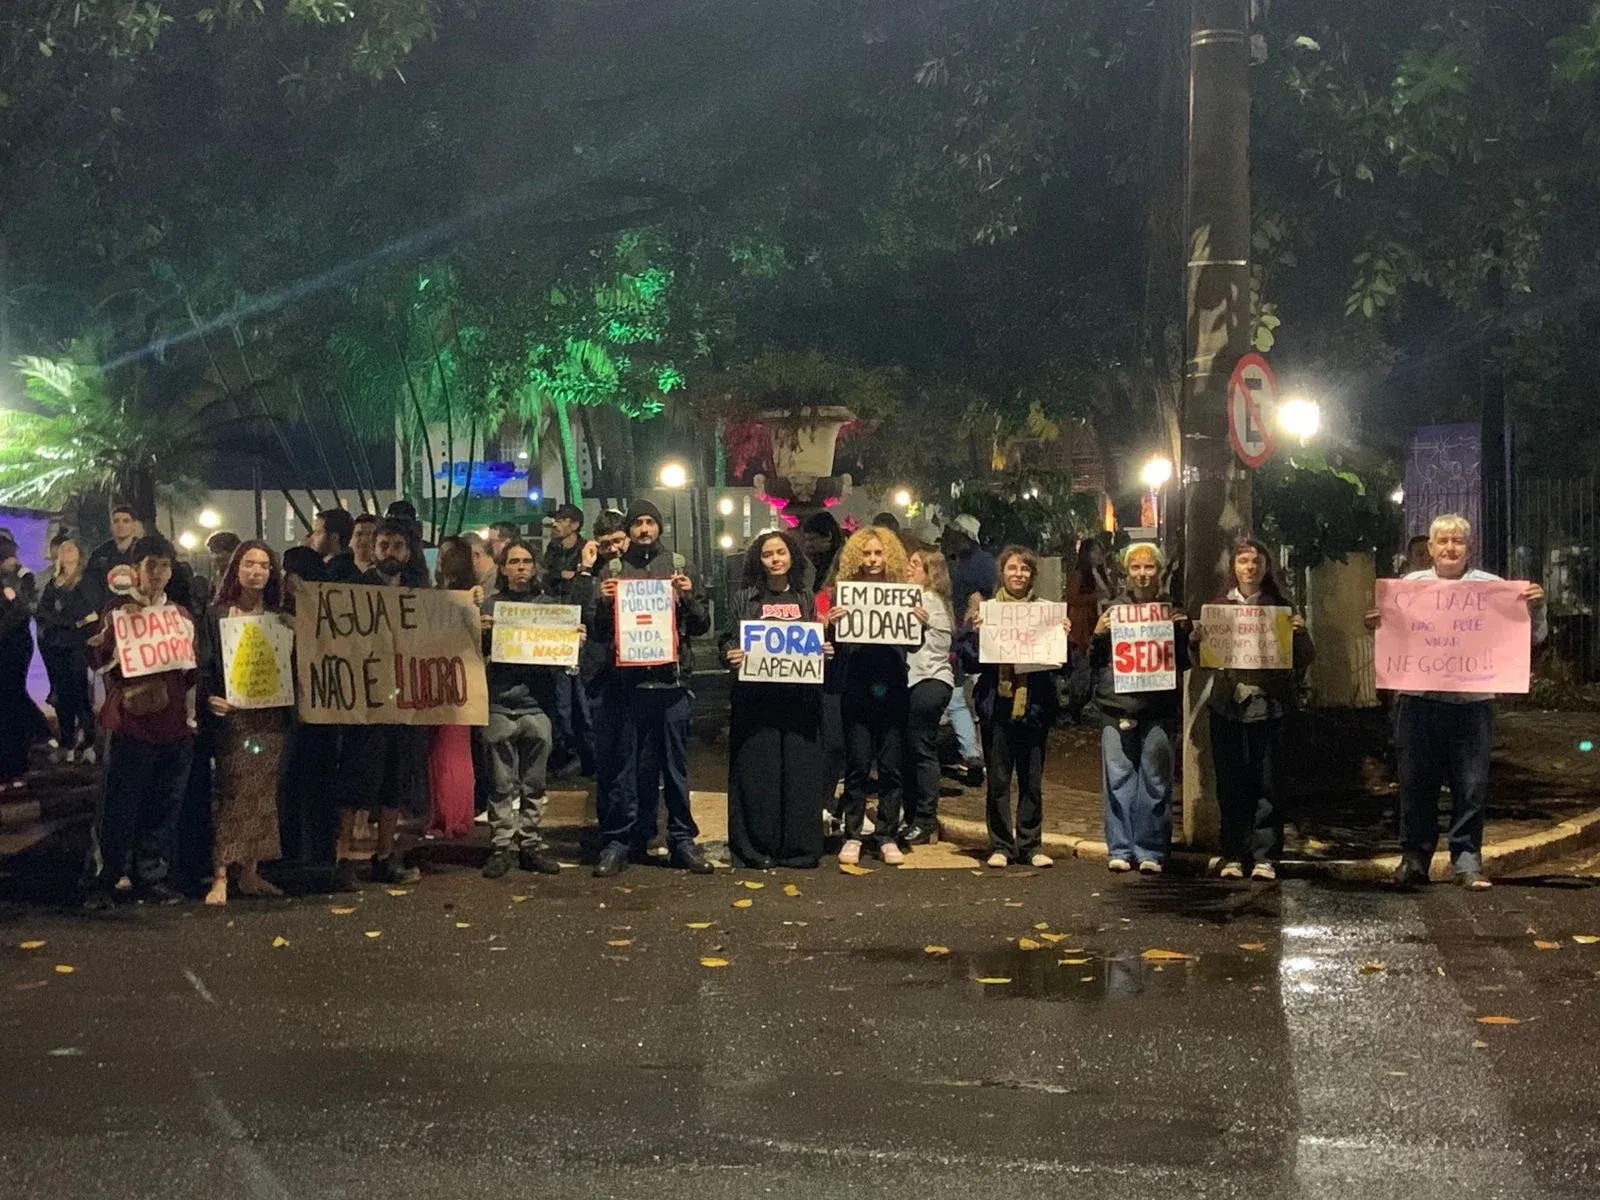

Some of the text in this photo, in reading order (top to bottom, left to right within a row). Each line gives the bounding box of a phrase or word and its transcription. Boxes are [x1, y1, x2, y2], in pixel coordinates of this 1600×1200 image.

[841, 586, 923, 607] EM DEFESA
[1436, 590, 1489, 611] DAAE
[316, 583, 393, 640] ÁGUA
[985, 604, 1062, 626] LAPENA
[1117, 603, 1171, 624] LUCRO
[1204, 606, 1267, 619] TEM TANTA
[116, 610, 185, 640] O DAAE
[245, 627, 259, 639] SE
[838, 609, 919, 640] DO DAAE
[989, 627, 1037, 643] vende
[1113, 627, 1136, 640] PARA
[628, 630, 662, 642] VIDA
[744, 624, 823, 656] FORA
[1209, 637, 1231, 649] QUE
[122, 639, 138, 673] É
[628, 647, 665, 660] DIGNA
[1115, 640, 1175, 673] SEDE
[744, 654, 821, 680] LAPENA!
[310, 651, 468, 711] NÃO É LUCRO
